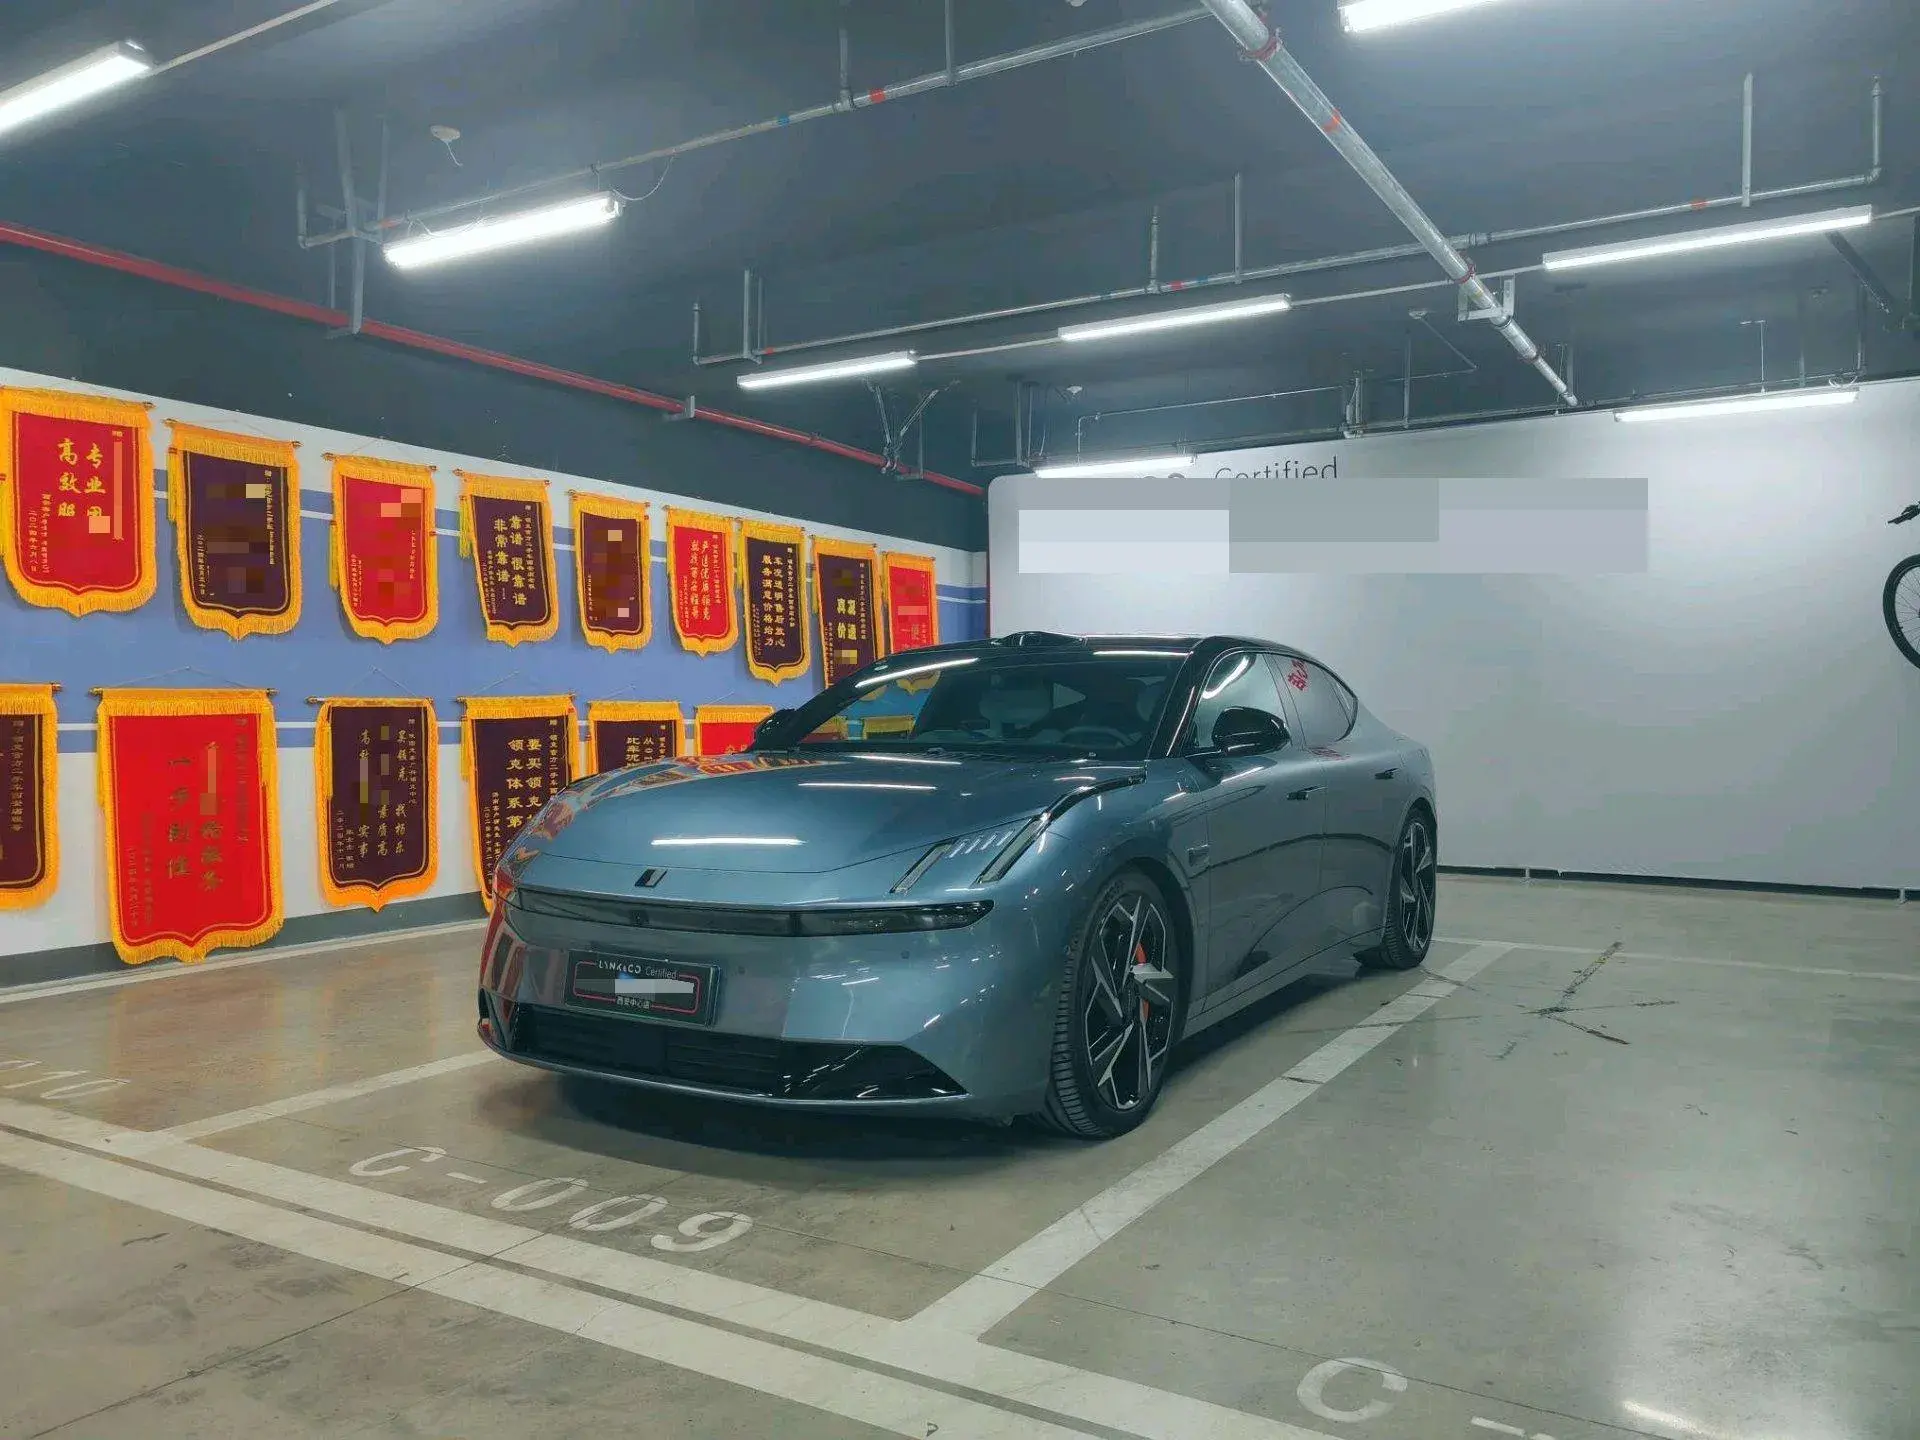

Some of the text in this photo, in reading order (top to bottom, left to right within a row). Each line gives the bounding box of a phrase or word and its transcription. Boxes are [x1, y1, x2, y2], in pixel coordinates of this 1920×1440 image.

[526, 738, 542, 819] 要买领克
[349, 1146, 754, 1253] C-009
[1296, 1357, 1556, 1440] C-
